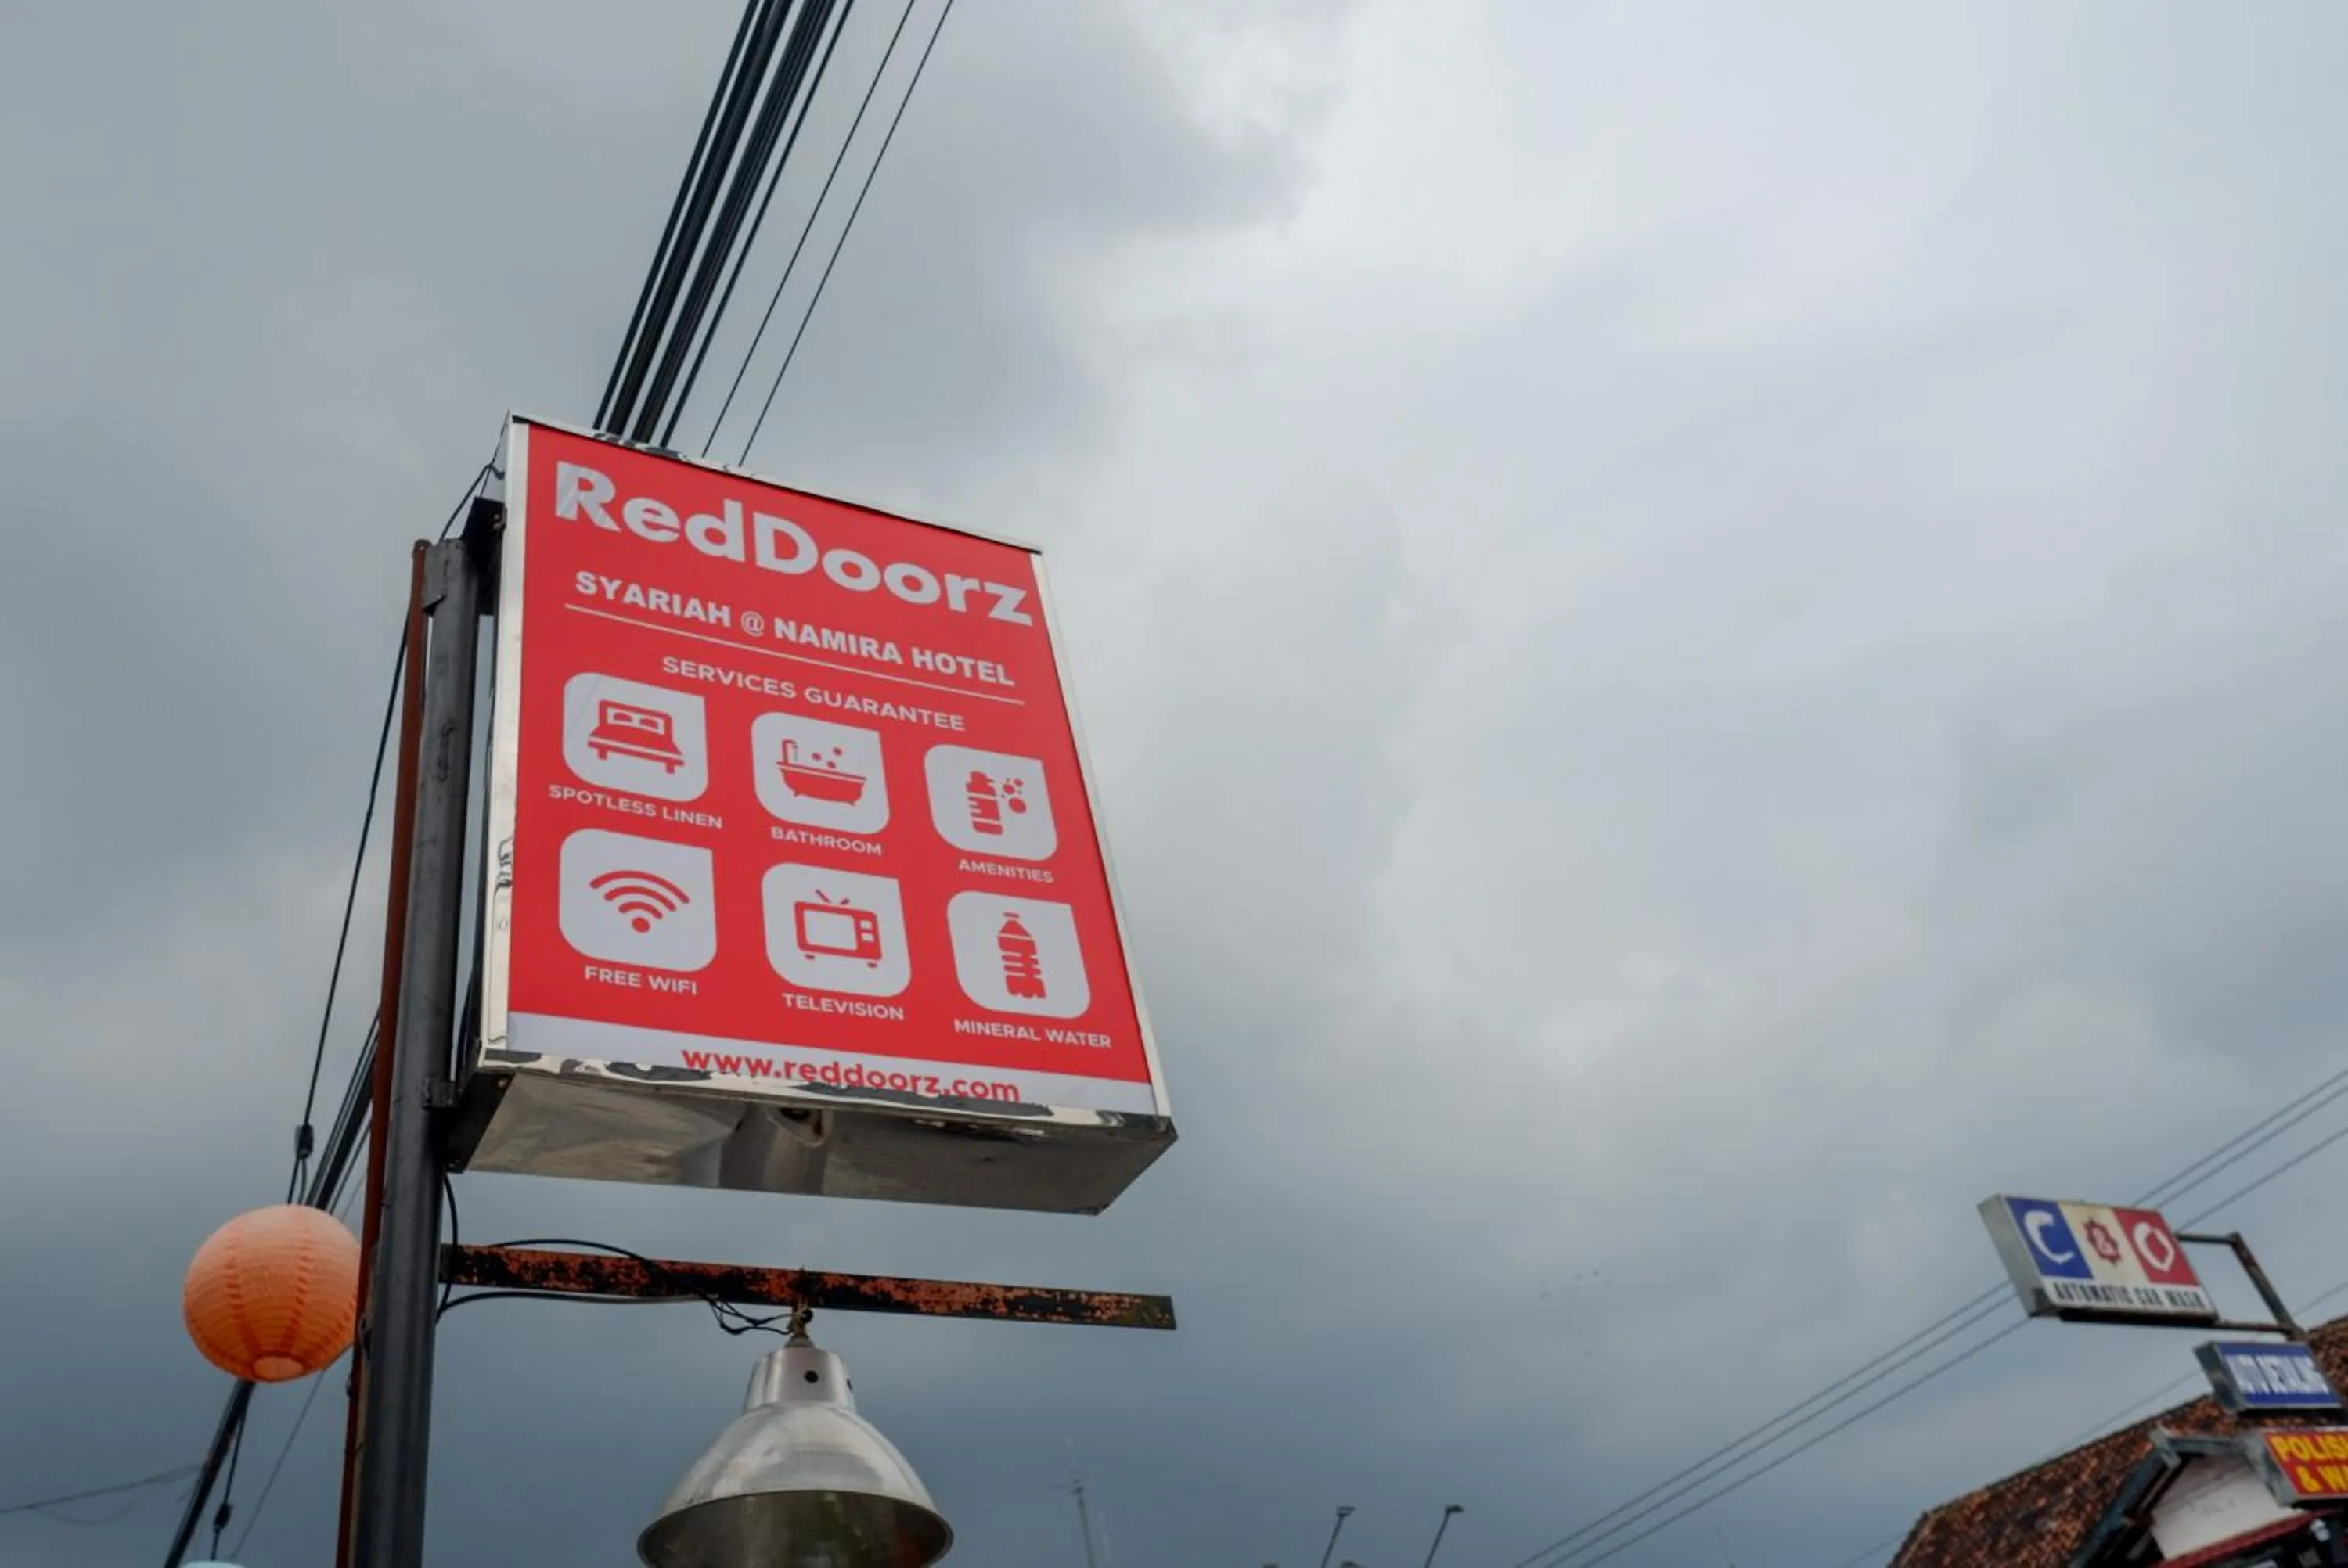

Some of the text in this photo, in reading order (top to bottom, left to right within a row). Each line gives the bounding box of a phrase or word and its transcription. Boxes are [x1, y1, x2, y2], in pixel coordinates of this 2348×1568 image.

[556, 460, 1033, 627] RedDoorz
[575, 570, 1015, 686] SYARIAH @ NAMIRA HOTEL
[663, 656, 966, 732] SERVICES GUARANTEE
[549, 784, 723, 829] SPOTLESS LINEN
[770, 826, 882, 855] BATHROOM
[958, 858, 1054, 883] AMENITIES
[584, 966, 697, 995] FREE WIFI
[782, 993, 905, 1020] TELEVISION
[953, 1019, 1113, 1049] MINERAL WATER
[681, 1049, 1021, 1102] www.reddoorz.com
